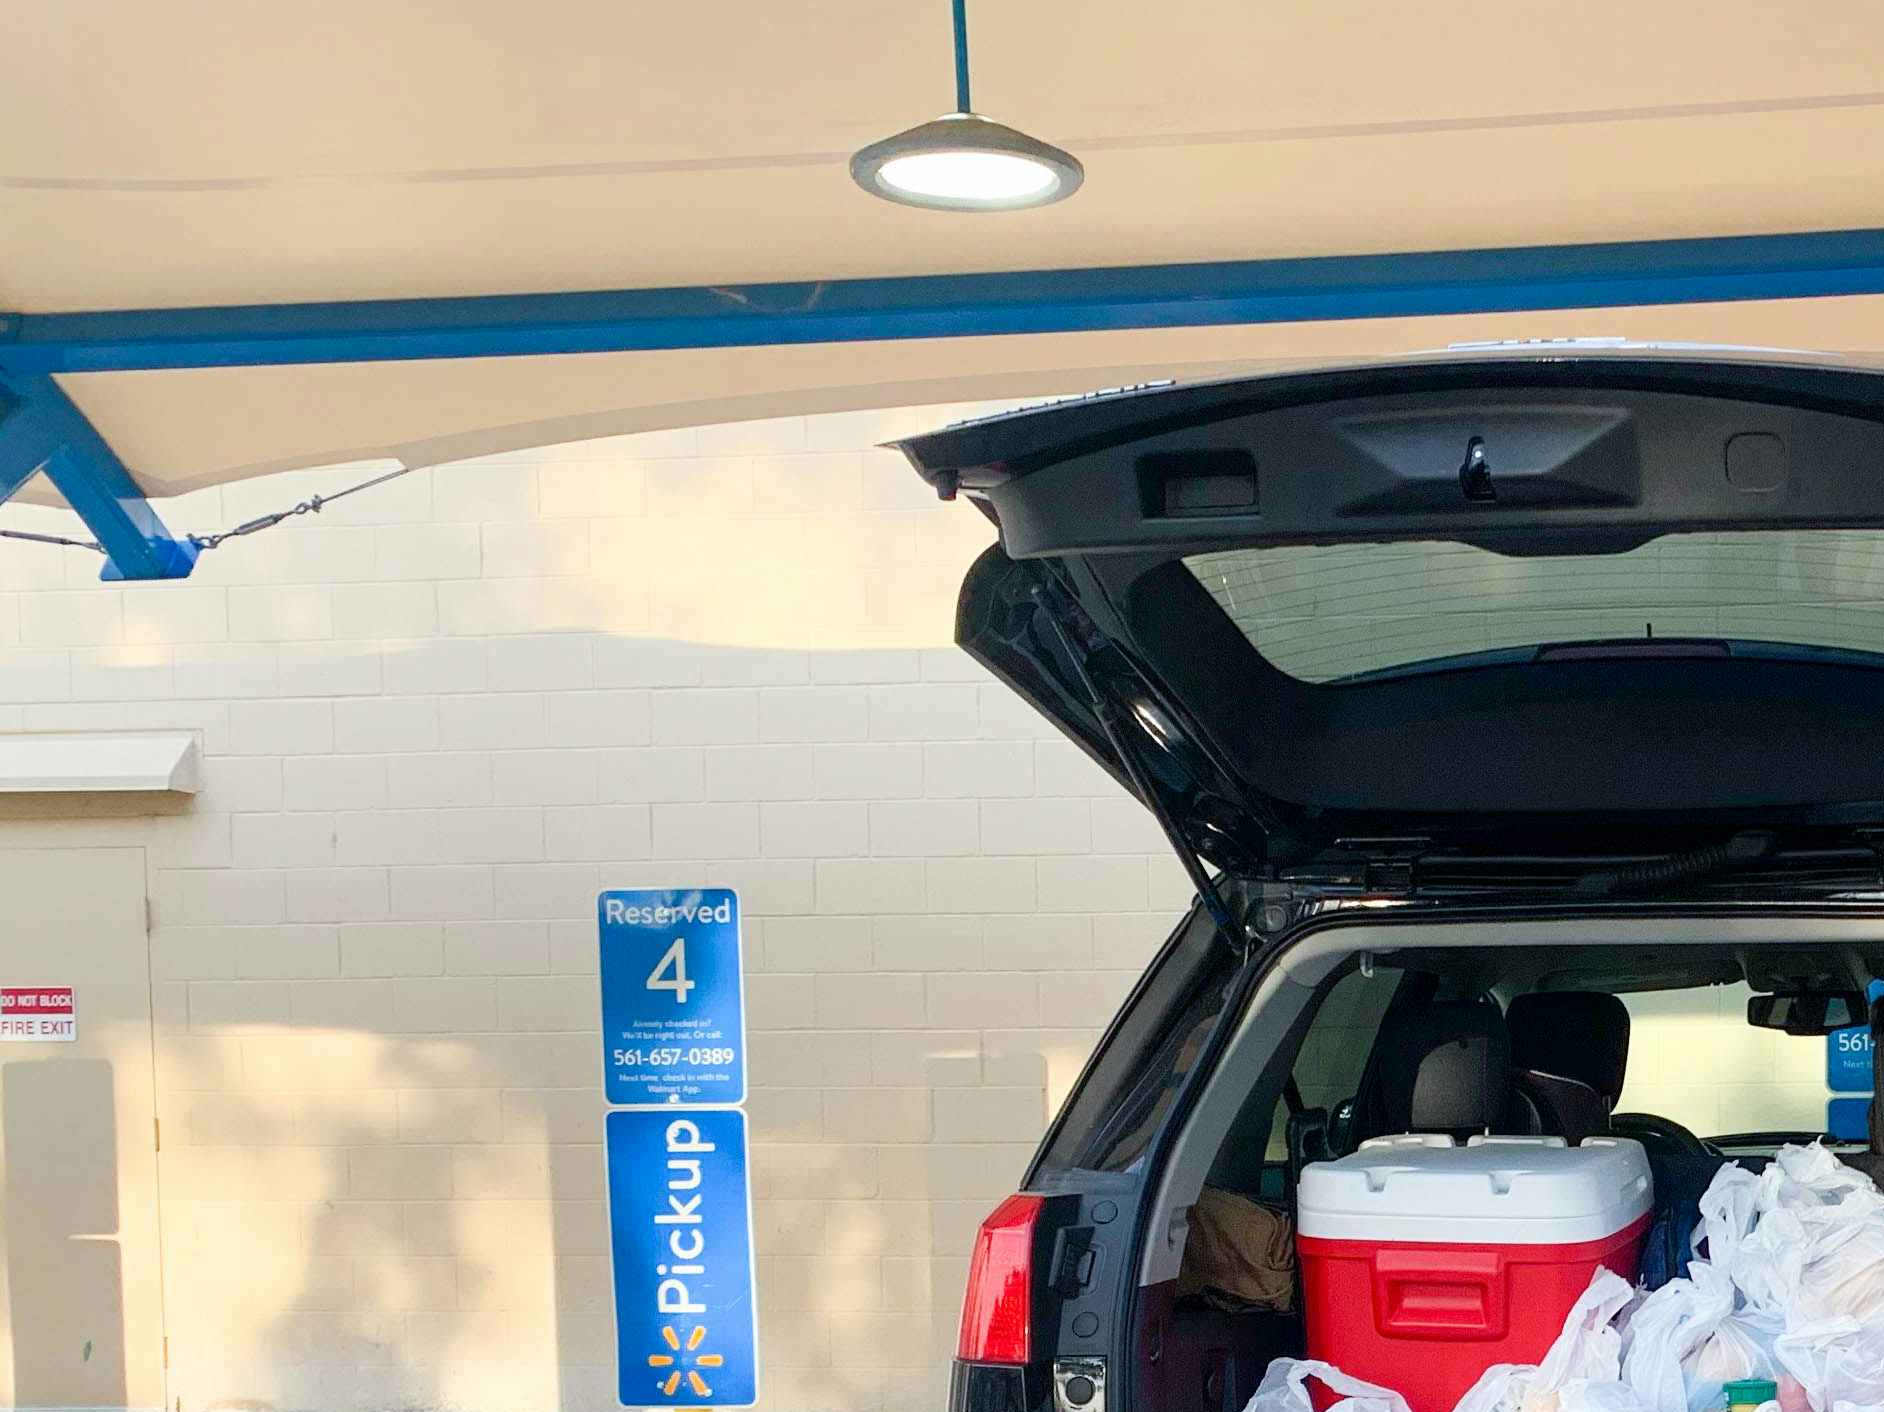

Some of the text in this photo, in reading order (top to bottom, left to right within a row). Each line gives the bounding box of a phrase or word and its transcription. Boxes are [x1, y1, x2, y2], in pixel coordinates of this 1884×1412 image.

[605, 898, 731, 925] Reserved
[646, 937, 696, 1004] 4
[0, 1021, 73, 1035] FIRE EXIT
[613, 1048, 734, 1067] 561-657-0389
[653, 1119, 716, 1314] Pickup
